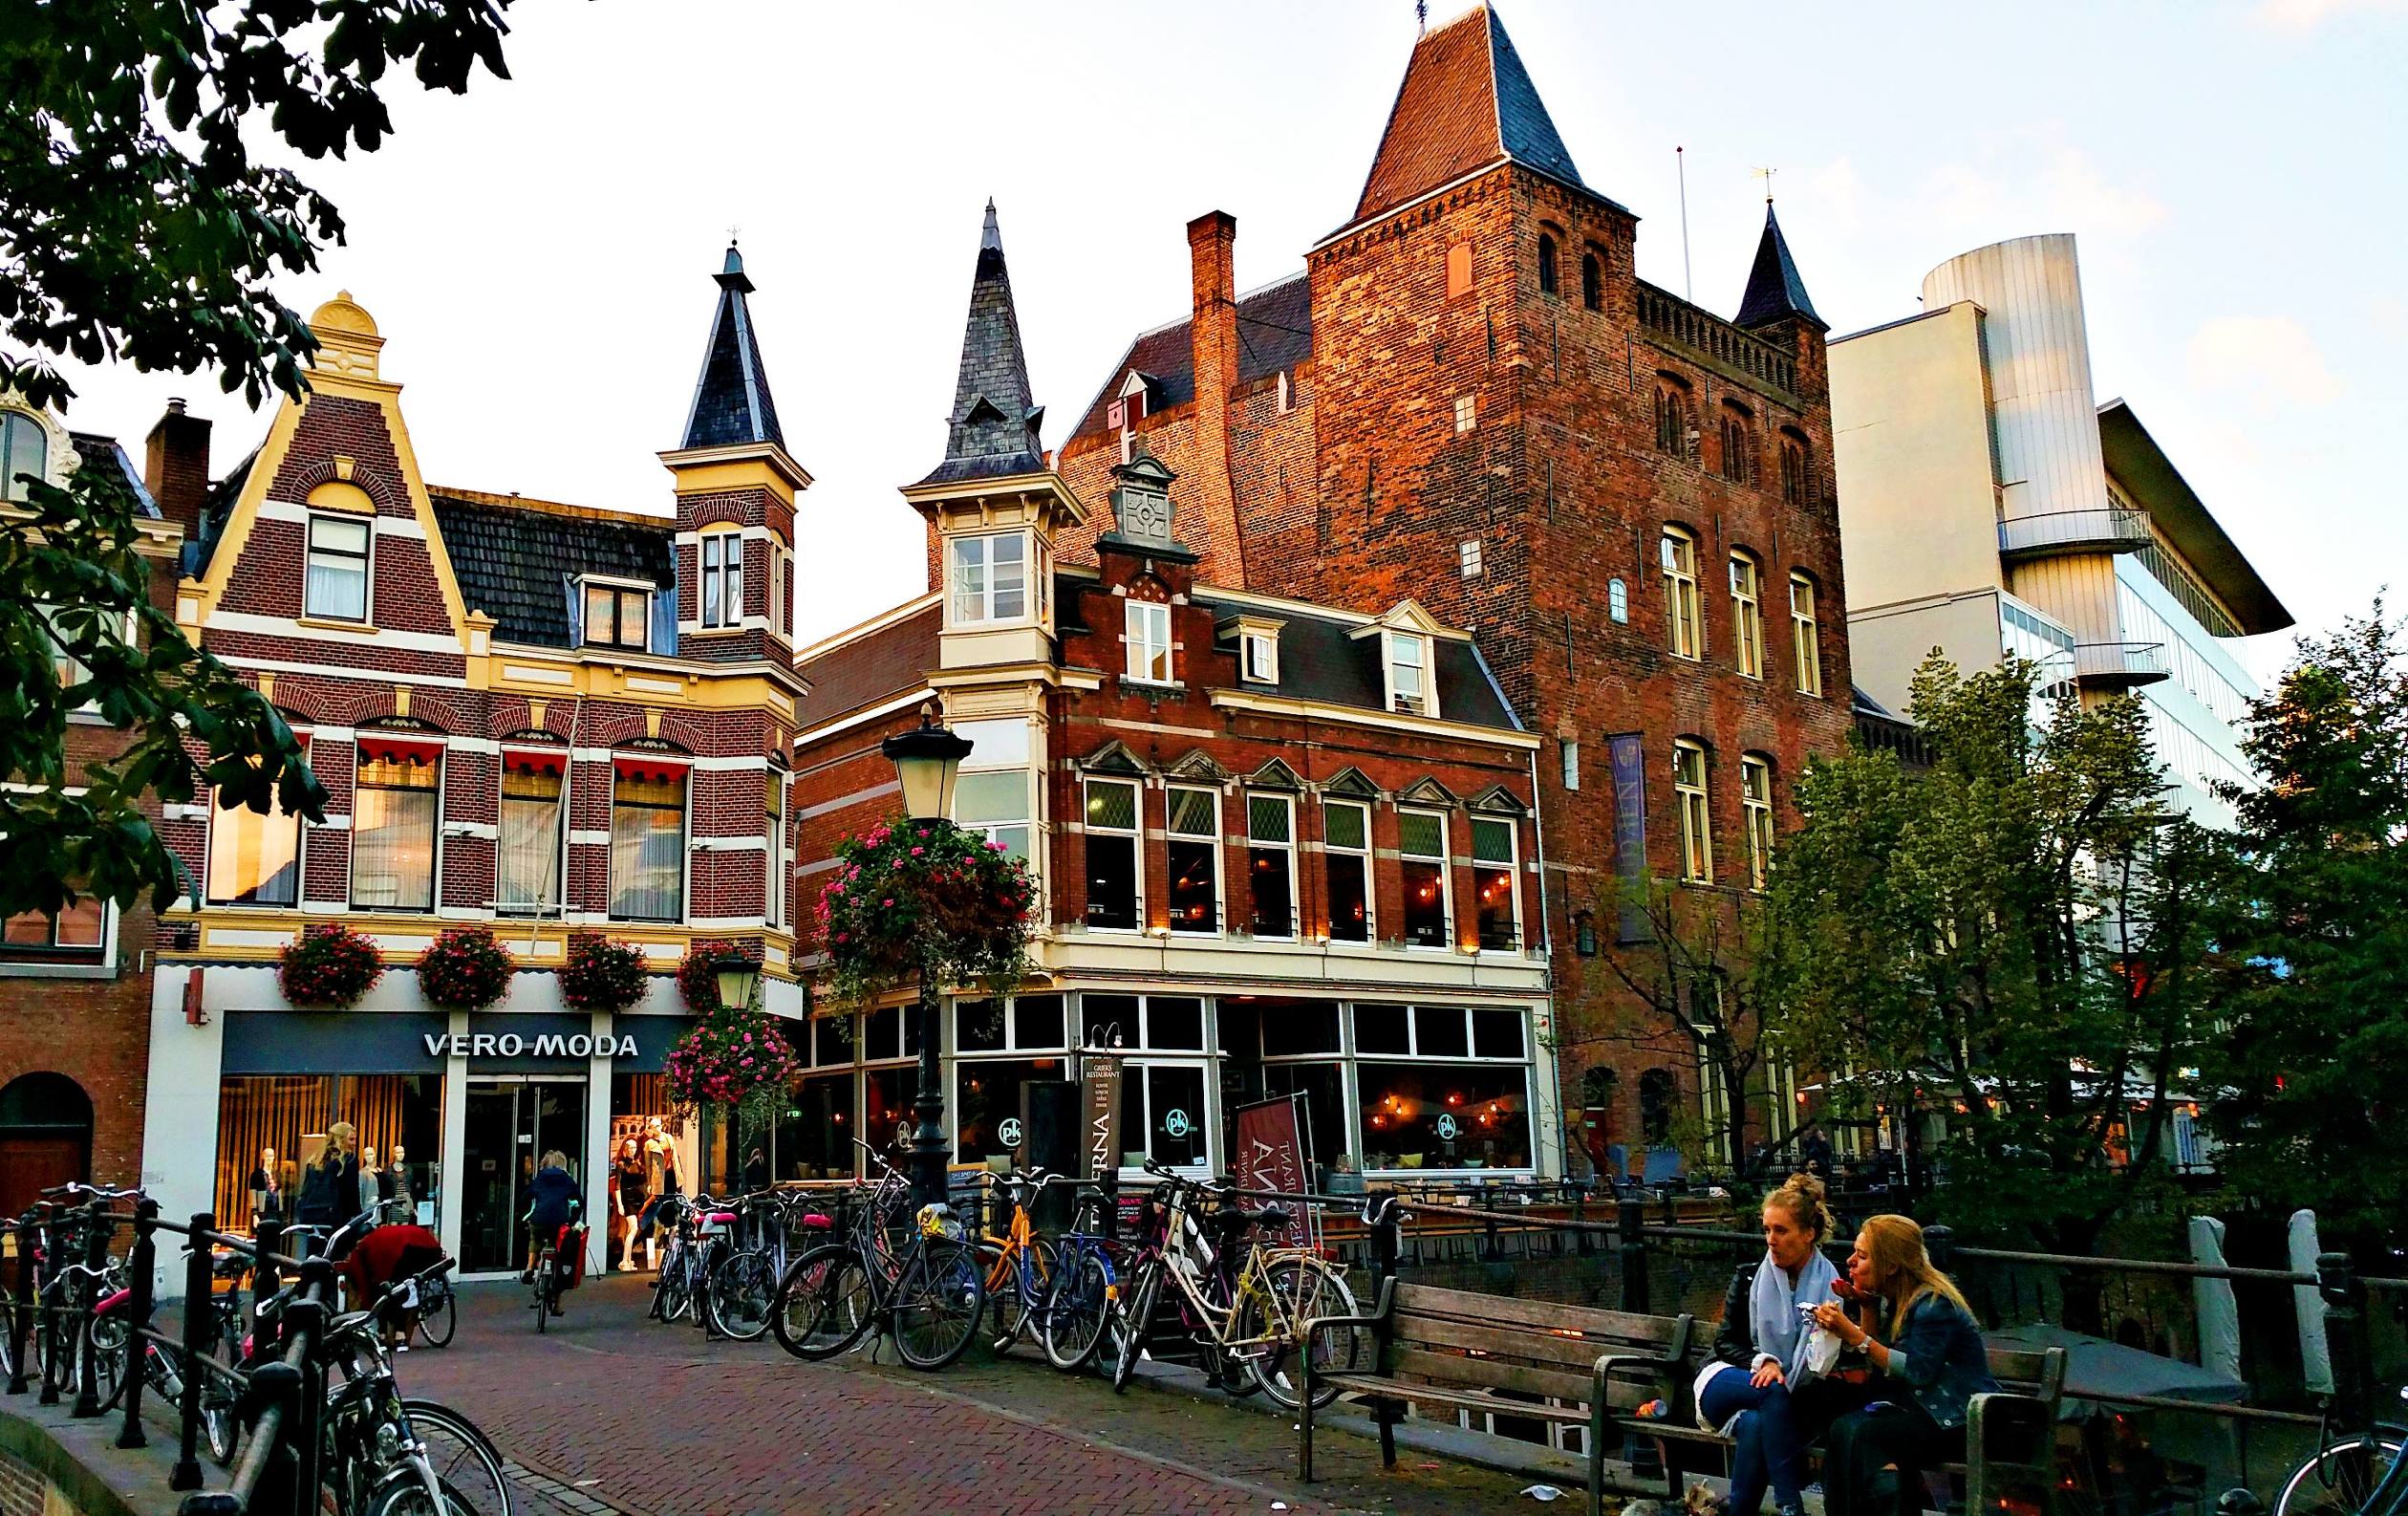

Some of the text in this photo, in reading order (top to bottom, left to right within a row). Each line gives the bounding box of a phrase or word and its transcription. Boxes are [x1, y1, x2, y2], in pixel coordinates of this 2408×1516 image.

[423, 1033, 639, 1057] VERO MODA
[1086, 1071, 1121, 1079] RESTAURANT
